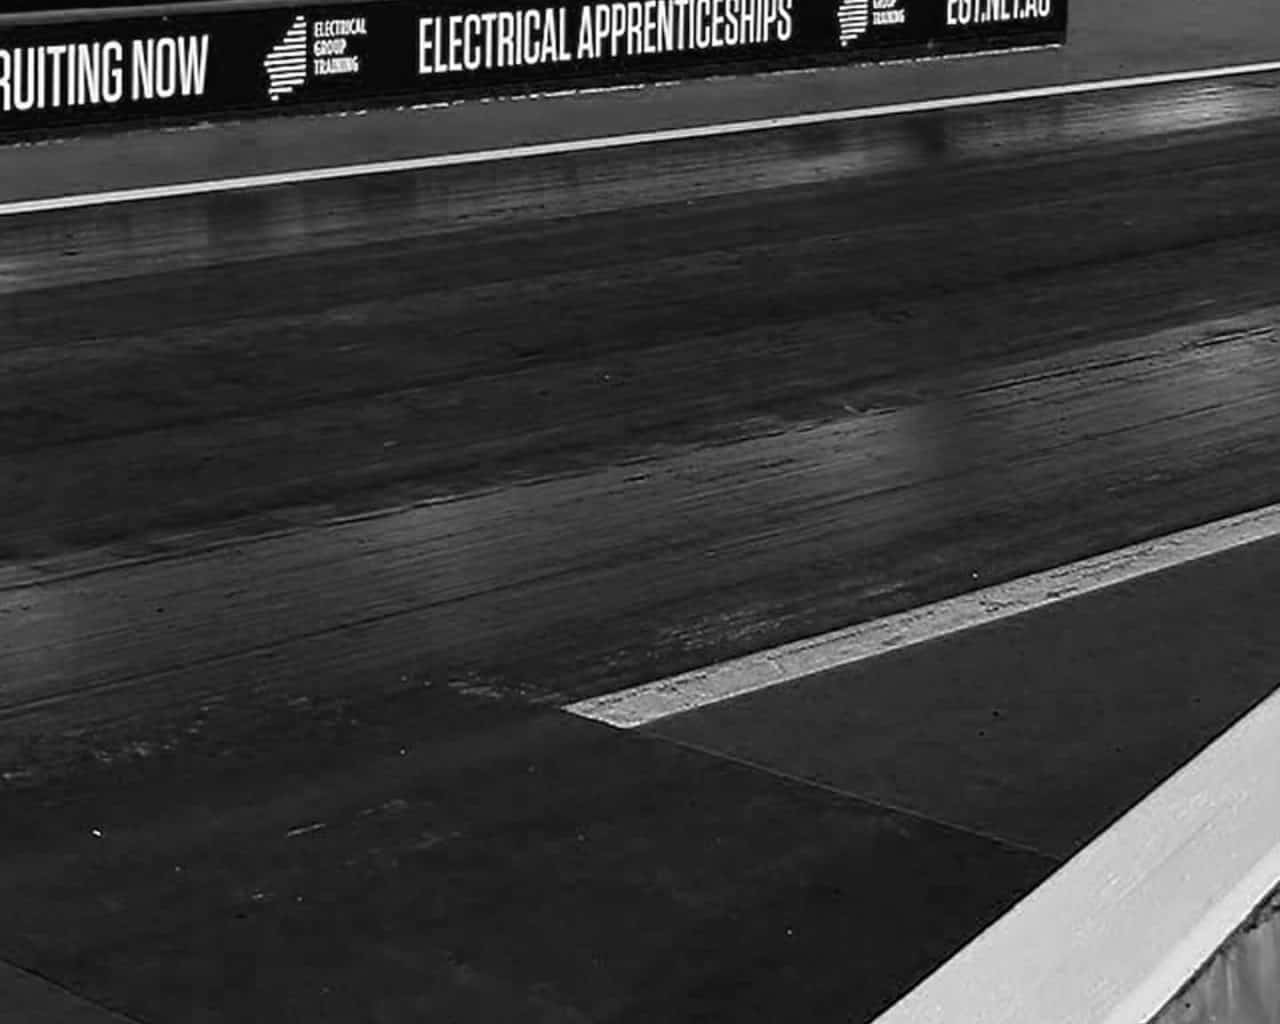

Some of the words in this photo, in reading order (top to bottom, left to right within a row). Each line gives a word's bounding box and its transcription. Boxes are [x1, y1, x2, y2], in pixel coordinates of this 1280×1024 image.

[313, 17, 368, 38] ELECTRICAL
[313, 37, 347, 57] GROUP
[418, 6, 572, 75] ELECTRICAL
[131, 34, 210, 101] NOW
[313, 55, 360, 76] TRAINING
